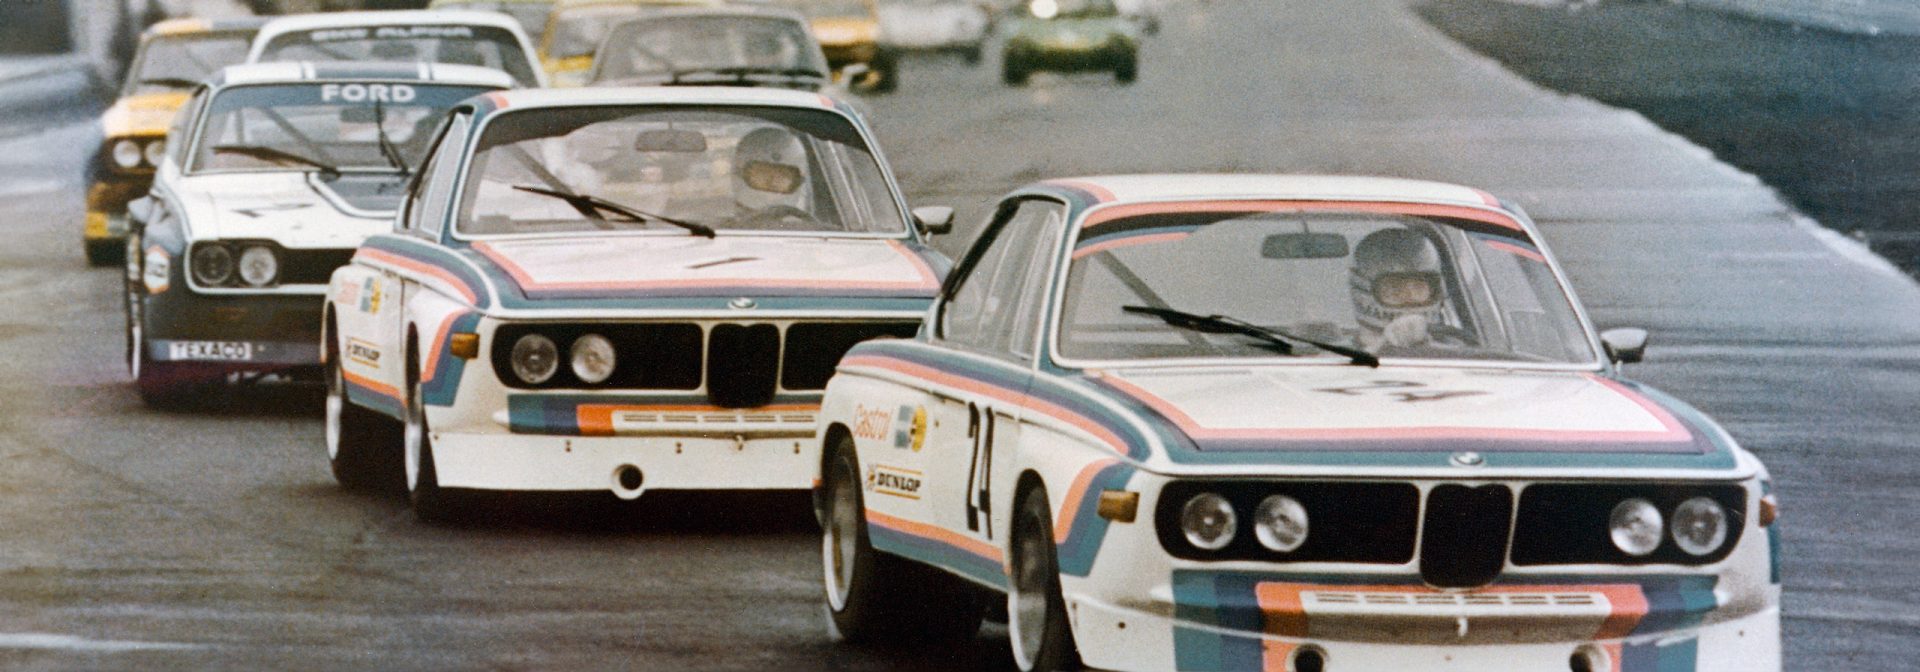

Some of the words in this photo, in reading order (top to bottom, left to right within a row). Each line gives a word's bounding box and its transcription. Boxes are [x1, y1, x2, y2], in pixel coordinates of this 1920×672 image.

[321, 83, 417, 102] FORD
[174, 342, 247, 358] TEXACO
[1311, 379, 1494, 402] 24
[854, 403, 894, 442] Castrol
[966, 401, 995, 540] 24
[877, 471, 922, 493] DUNLOP
